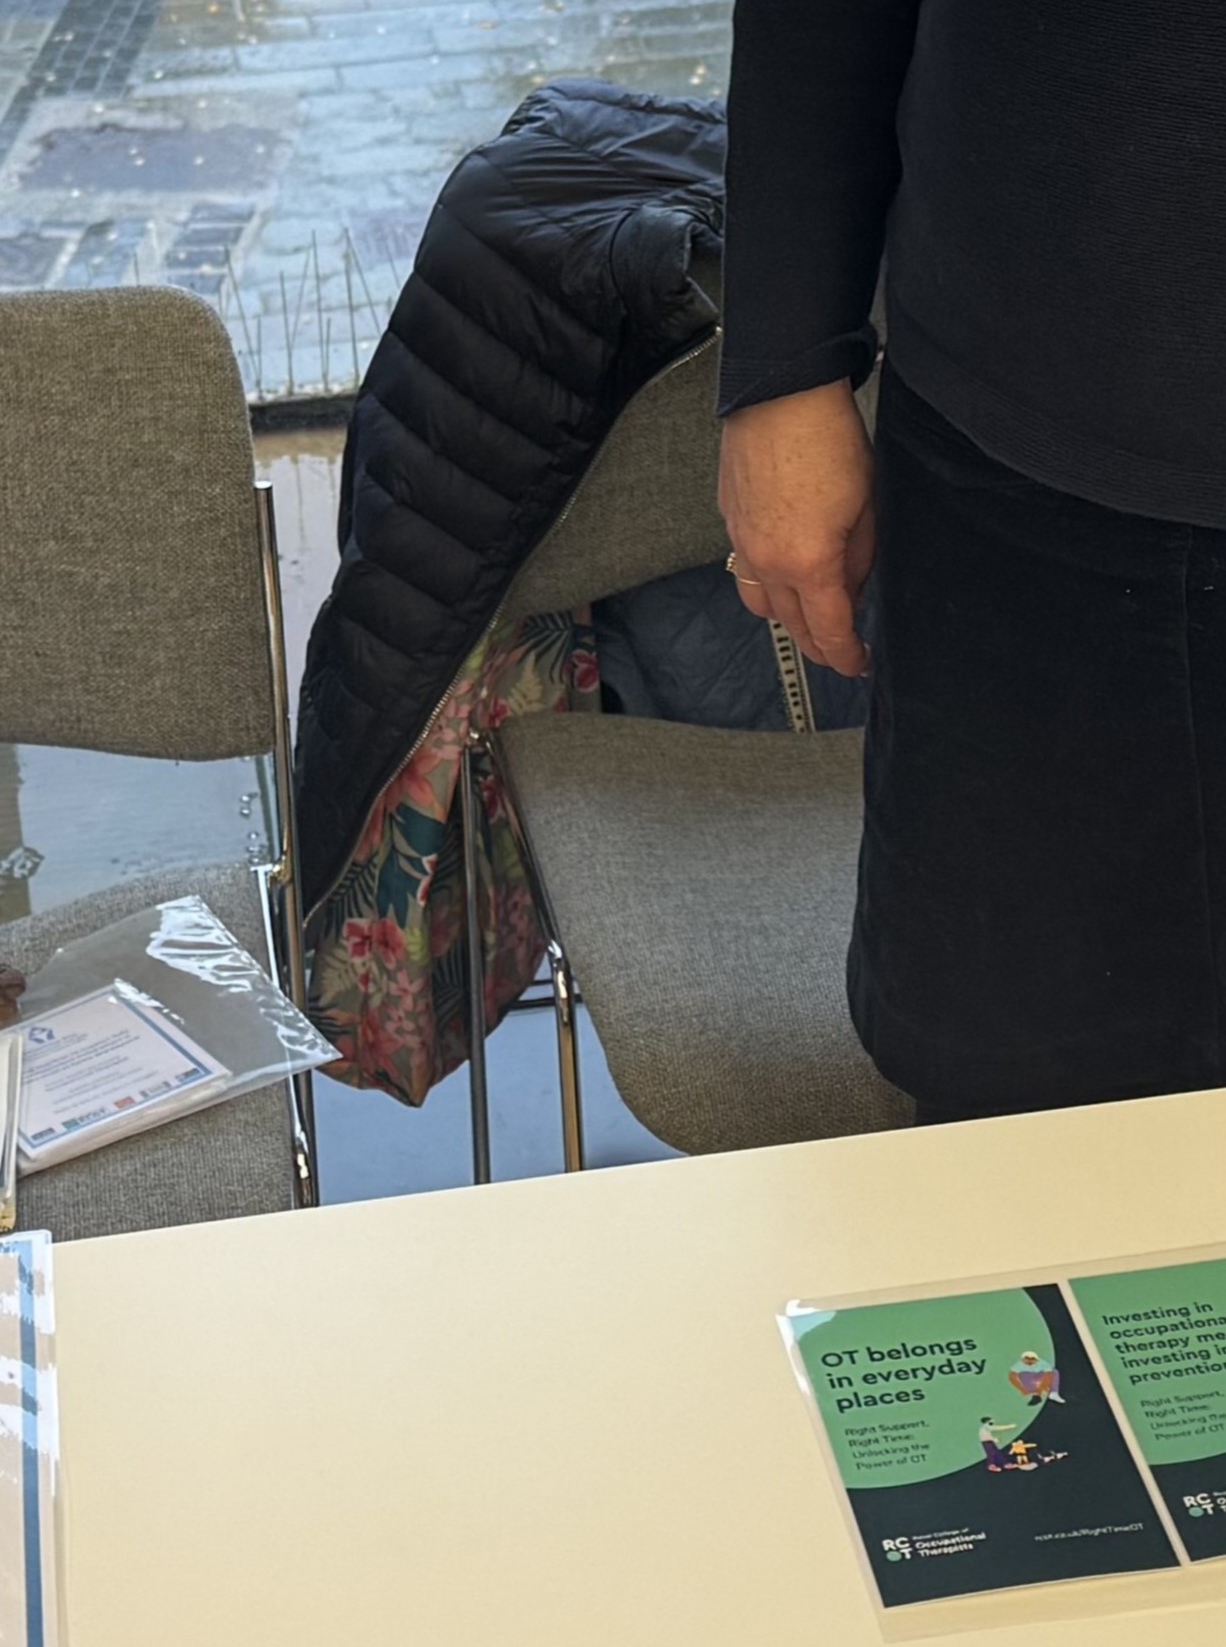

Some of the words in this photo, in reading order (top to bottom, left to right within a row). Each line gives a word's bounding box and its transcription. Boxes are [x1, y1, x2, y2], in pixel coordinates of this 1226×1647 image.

[1102, 1306, 1191, 1326] Investing
[1193, 1302, 1213, 1313] in
[821, 1349, 859, 1367] OT
[866, 1338, 977, 1362] belongs
[1115, 1336, 1190, 1354] therapy
[1121, 1348, 1211, 1369] investing
[826, 1373, 853, 1389] in
[862, 1358, 987, 1385] everyday
[836, 1388, 925, 1414] places
[1140, 1397, 1172, 1408] Right
[1144, 1408, 1176, 1419] Right
[845, 1426, 876, 1437] Right
[848, 1437, 880, 1448] Right
[852, 1446, 910, 1459] Unlocking
[911, 1442, 930, 1452] the
[856, 1460, 893, 1470] Power
[910, 1453, 927, 1464] OT
